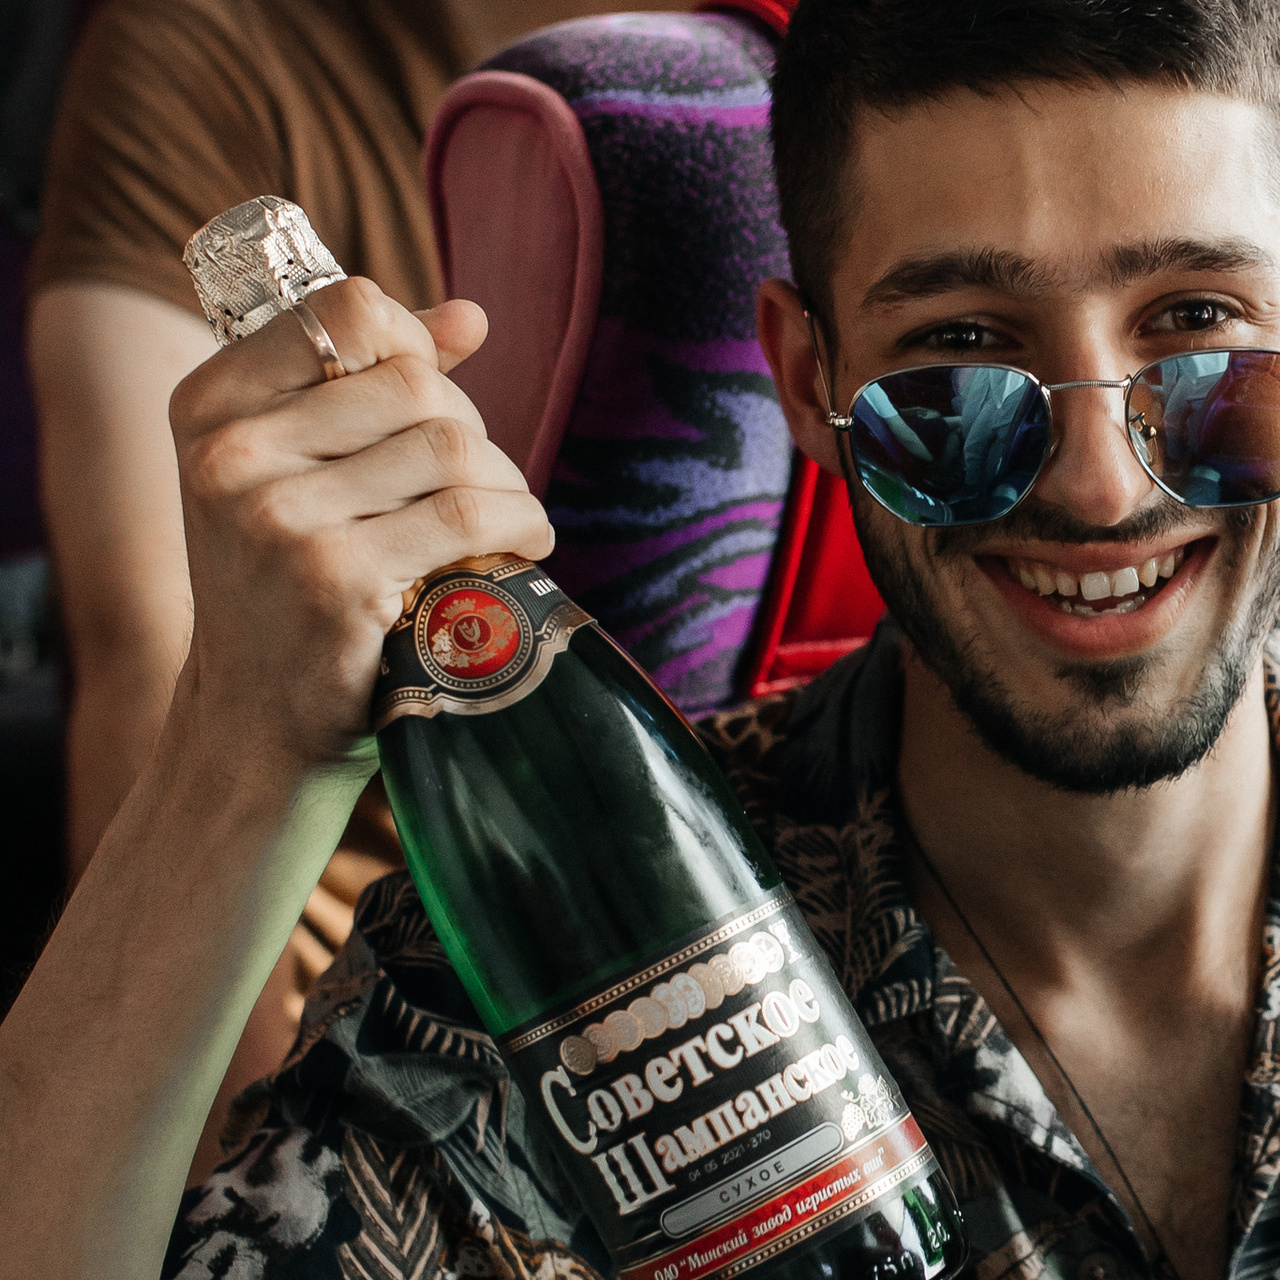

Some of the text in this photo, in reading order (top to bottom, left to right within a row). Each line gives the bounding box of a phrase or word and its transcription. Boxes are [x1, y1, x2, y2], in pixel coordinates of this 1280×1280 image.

[541, 979, 820, 1154] Советское
[592, 1035, 859, 1215] Шампанское
[720, 1161, 785, 1203] СУХОЕ
[752, 1204, 792, 1239] завод
[796, 1168, 862, 1217] игристых
